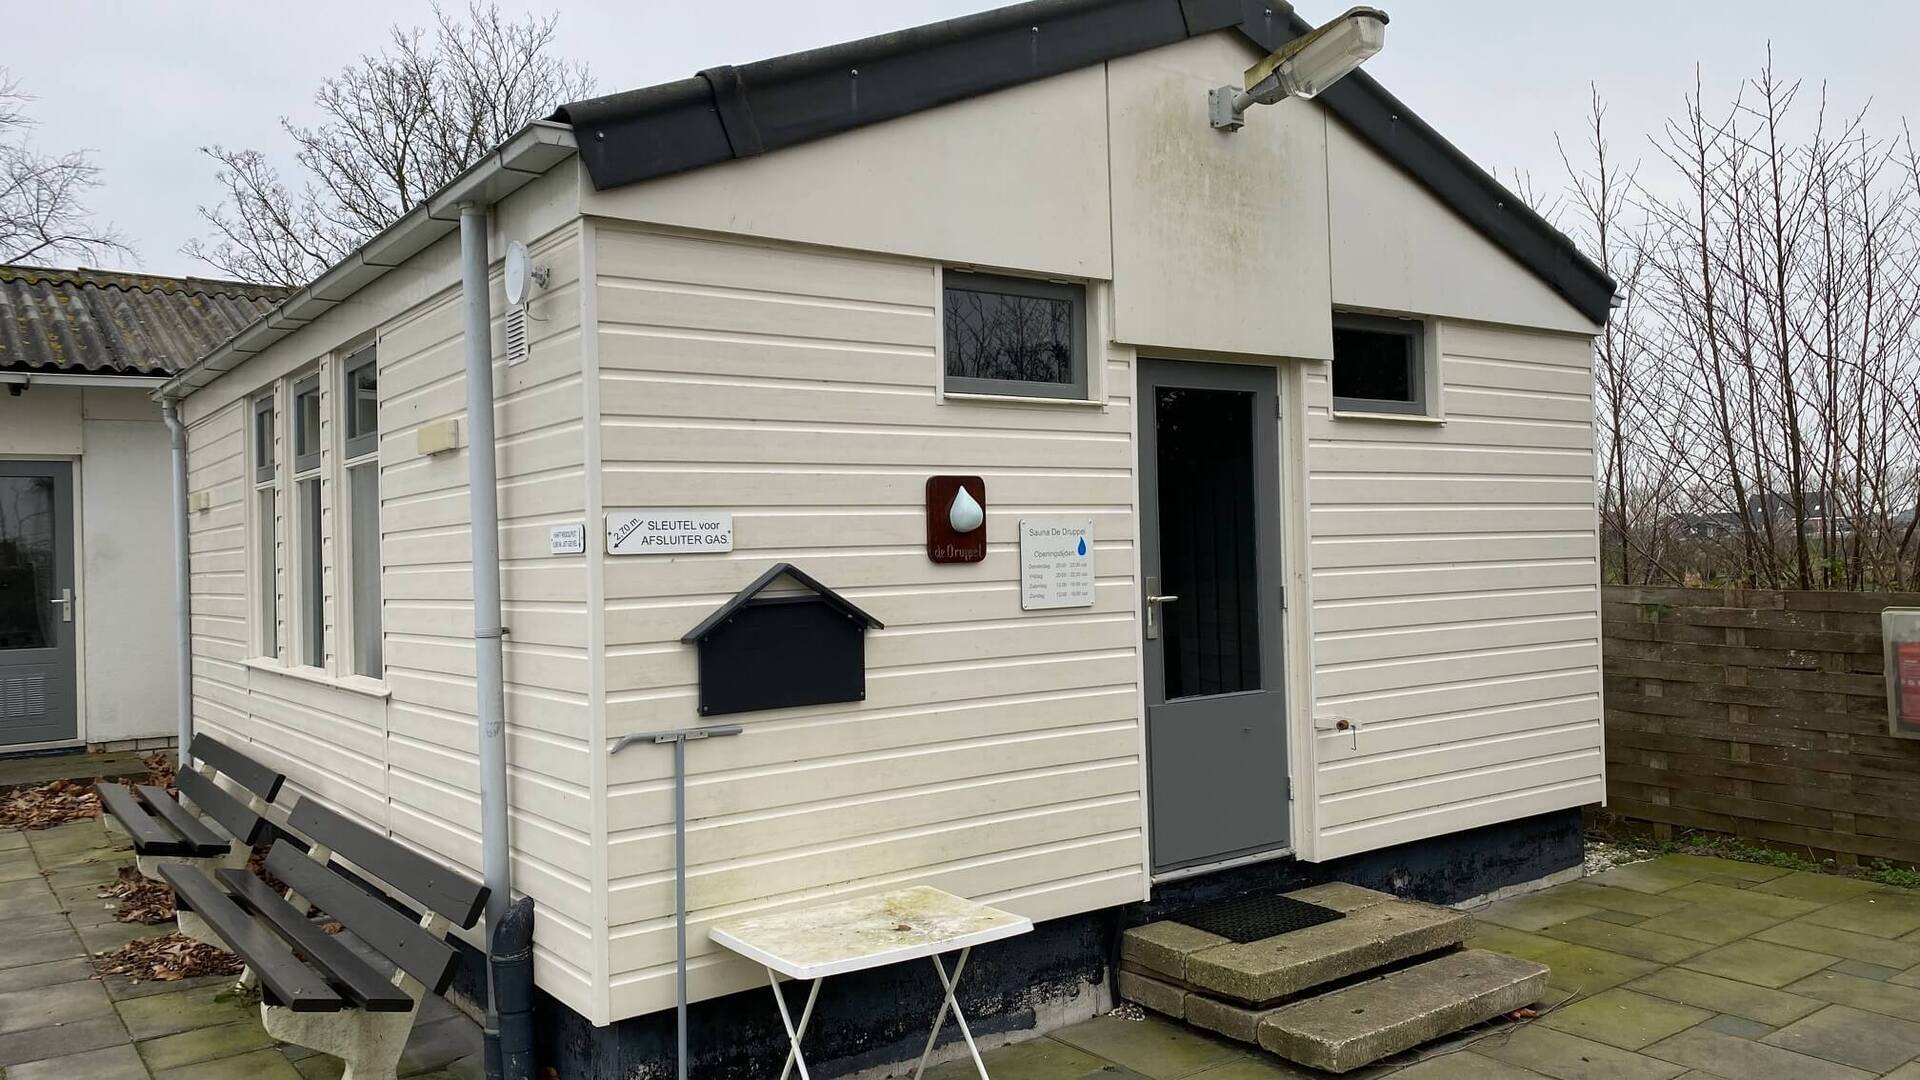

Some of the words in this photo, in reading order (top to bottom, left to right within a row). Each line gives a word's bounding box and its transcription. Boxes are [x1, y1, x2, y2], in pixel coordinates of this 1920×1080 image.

[647, 520, 697, 531] SLEUTEL
[699, 522, 720, 530] voor
[613, 523, 631, 541] 2,70
[1029, 528, 1050, 537] Sauna
[1051, 527, 1061, 536] De
[1062, 527, 1086, 537] Druppel
[641, 535, 702, 546] AFSLUITER
[947, 543, 983, 561] Druppel
